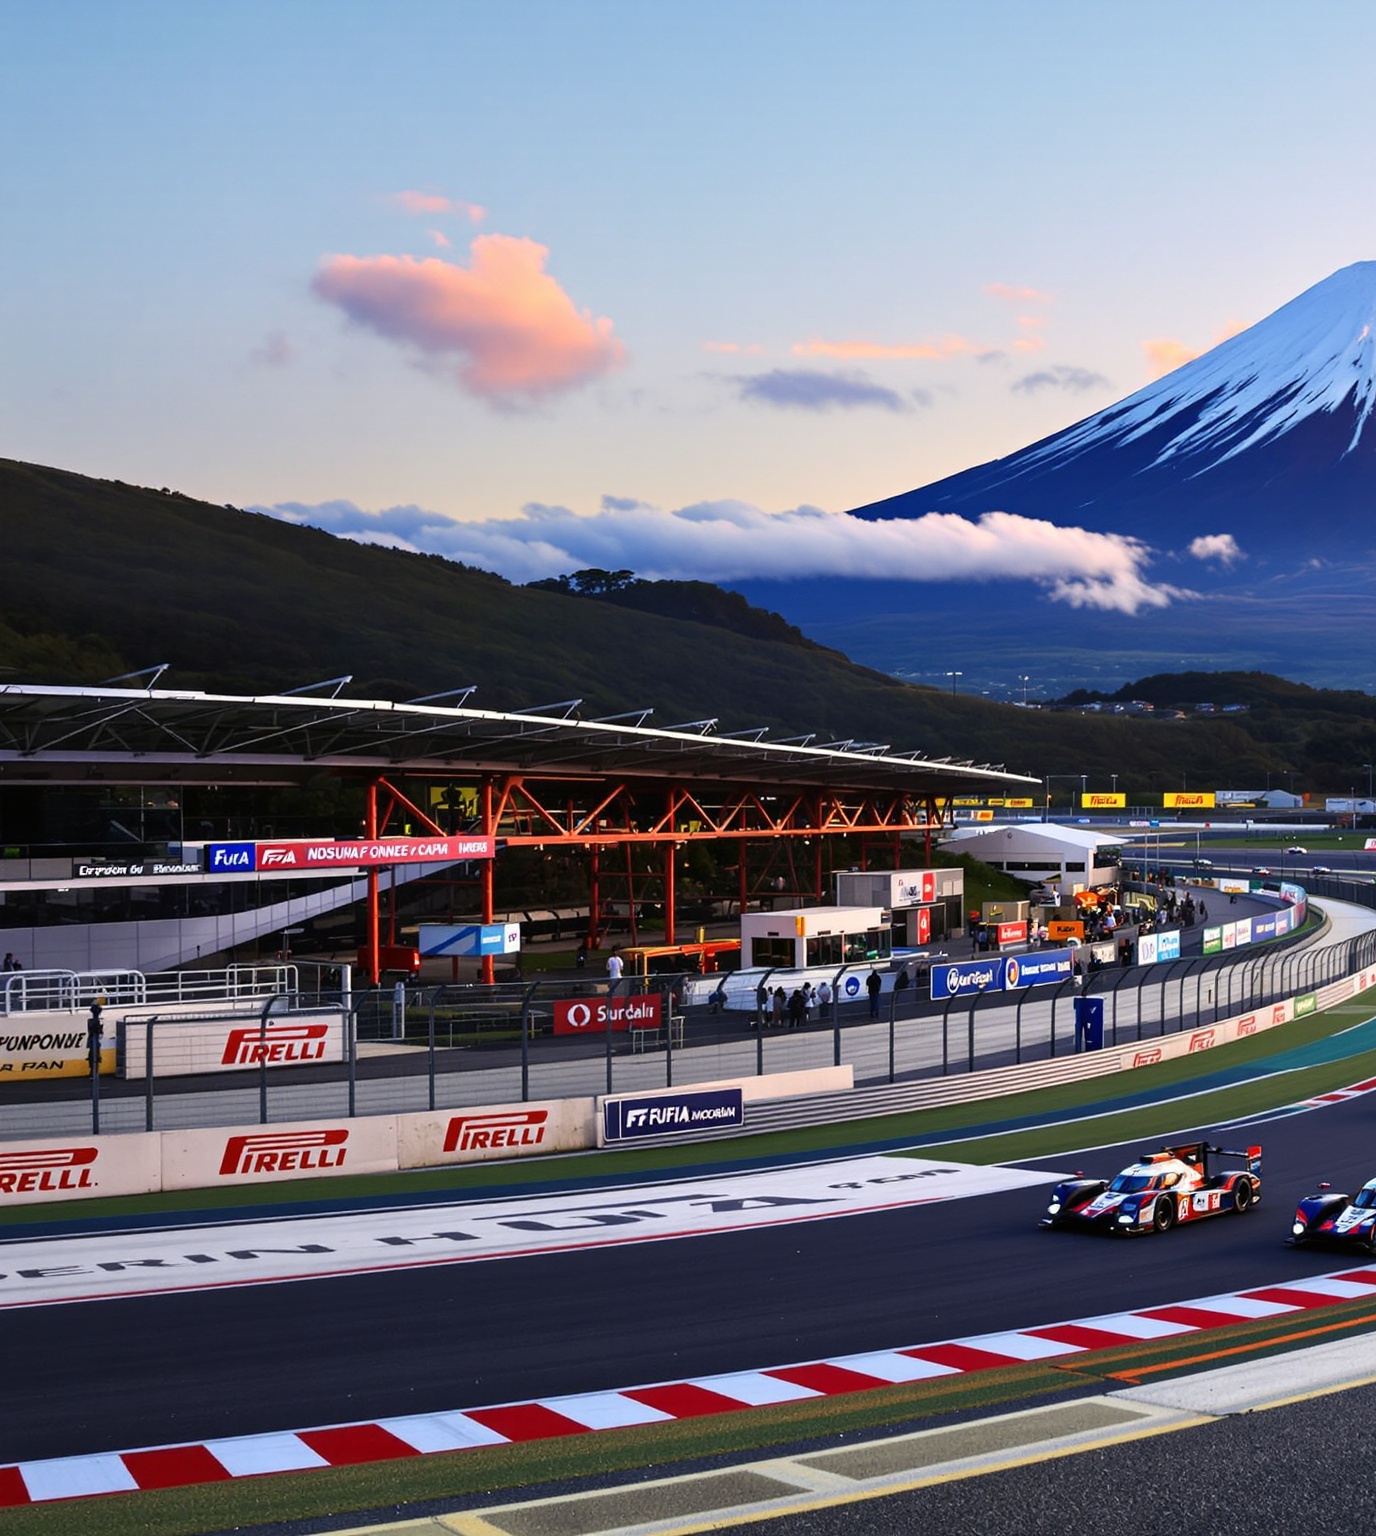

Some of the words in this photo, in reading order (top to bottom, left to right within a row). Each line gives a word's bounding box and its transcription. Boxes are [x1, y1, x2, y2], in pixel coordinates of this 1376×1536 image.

[221, 1024, 329, 1065] PIRELLI
[219, 1129, 349, 1175] PIRELLI
[443, 1110, 548, 1152] PIRELLI
